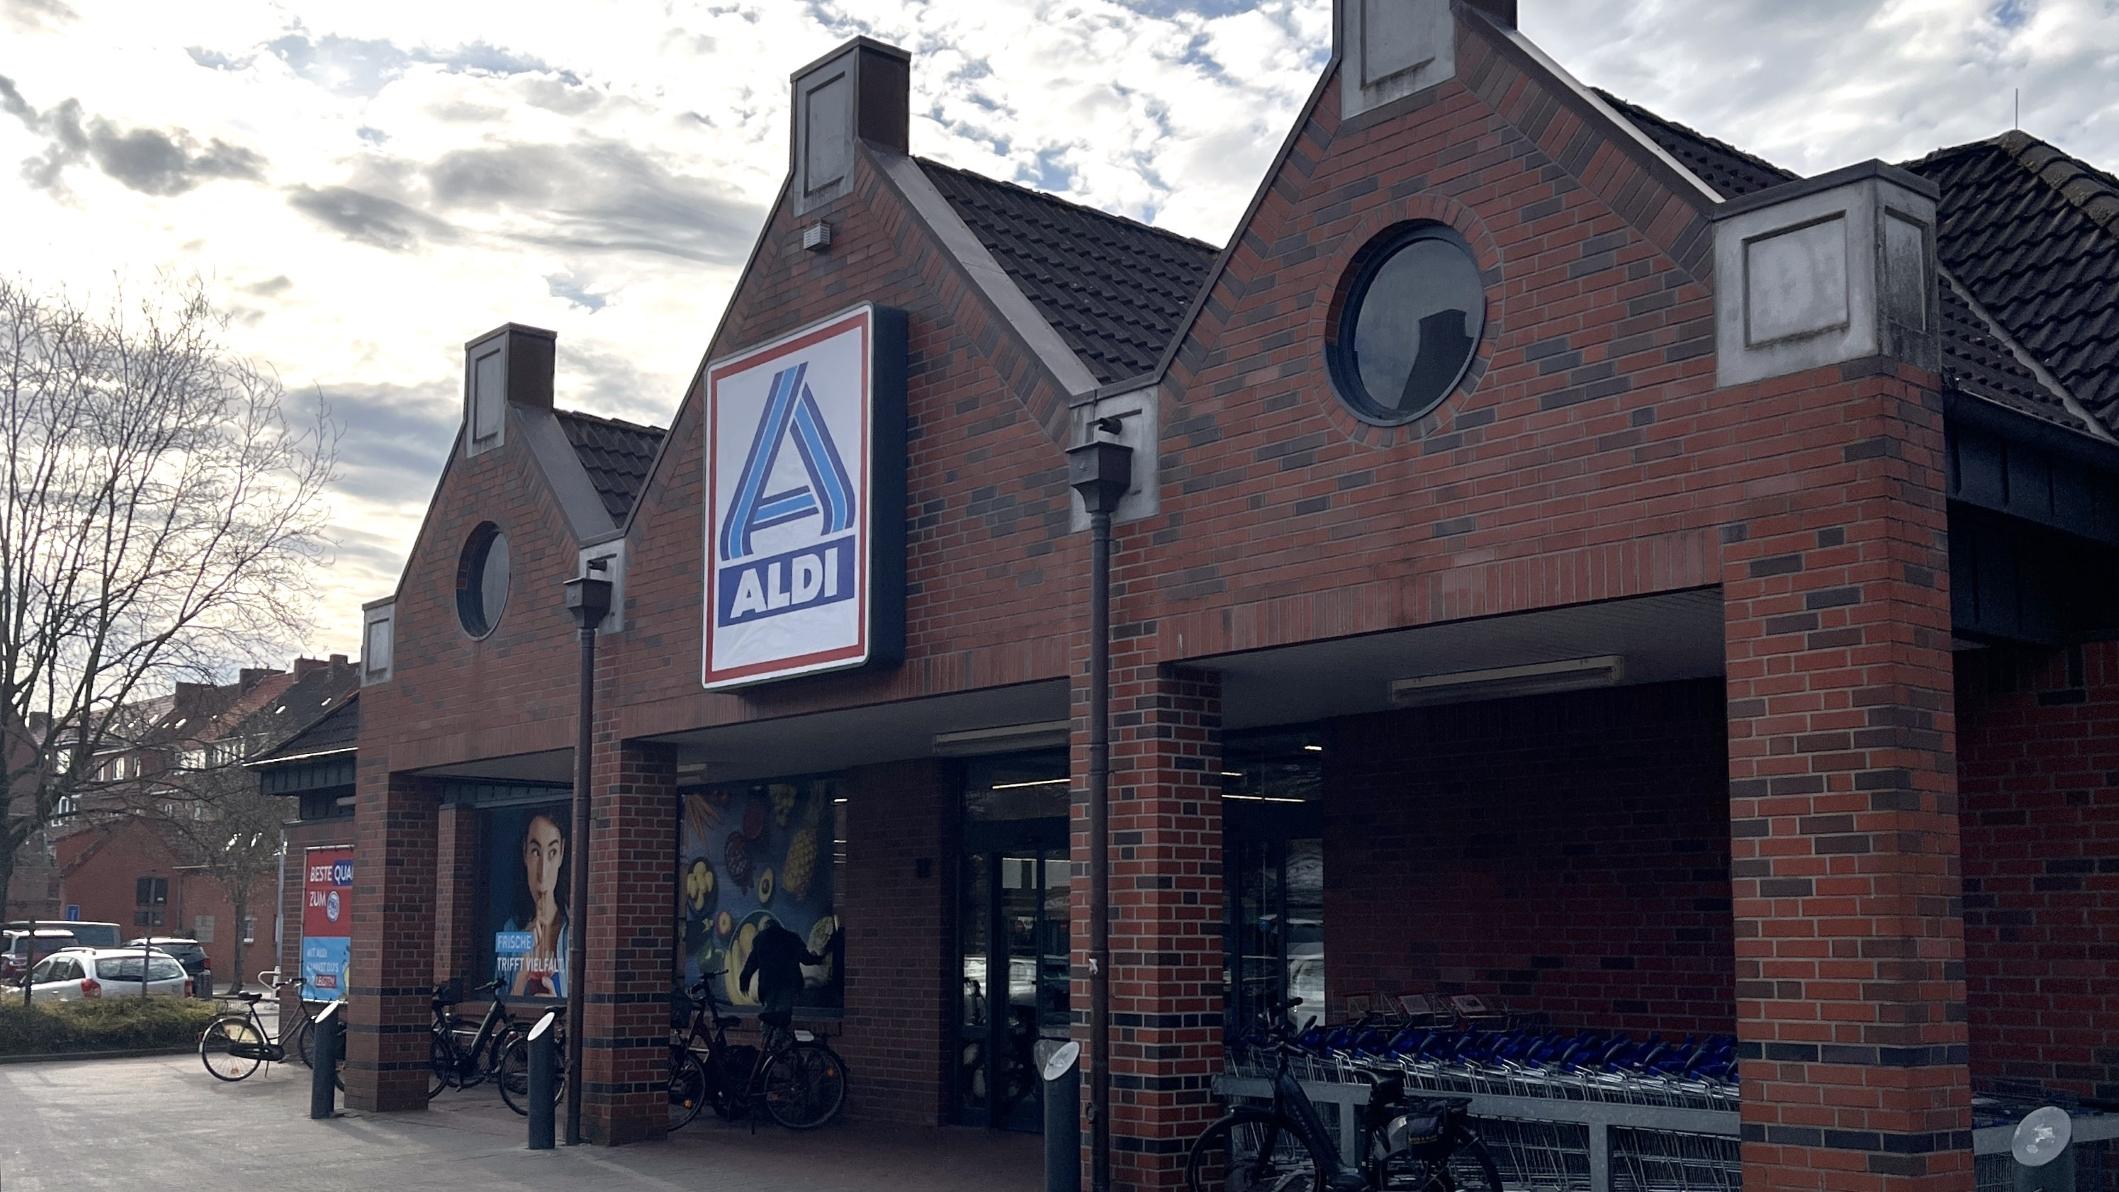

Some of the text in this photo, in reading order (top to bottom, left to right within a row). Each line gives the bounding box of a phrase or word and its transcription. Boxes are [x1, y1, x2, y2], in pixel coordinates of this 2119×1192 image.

[730, 547, 838, 619] ALDI
[310, 865, 353, 885] BESTE QUA
[309, 890, 326, 907] ZUM
[497, 935, 532, 949] FRISCHE
[497, 957, 524, 972] TRIFFT
